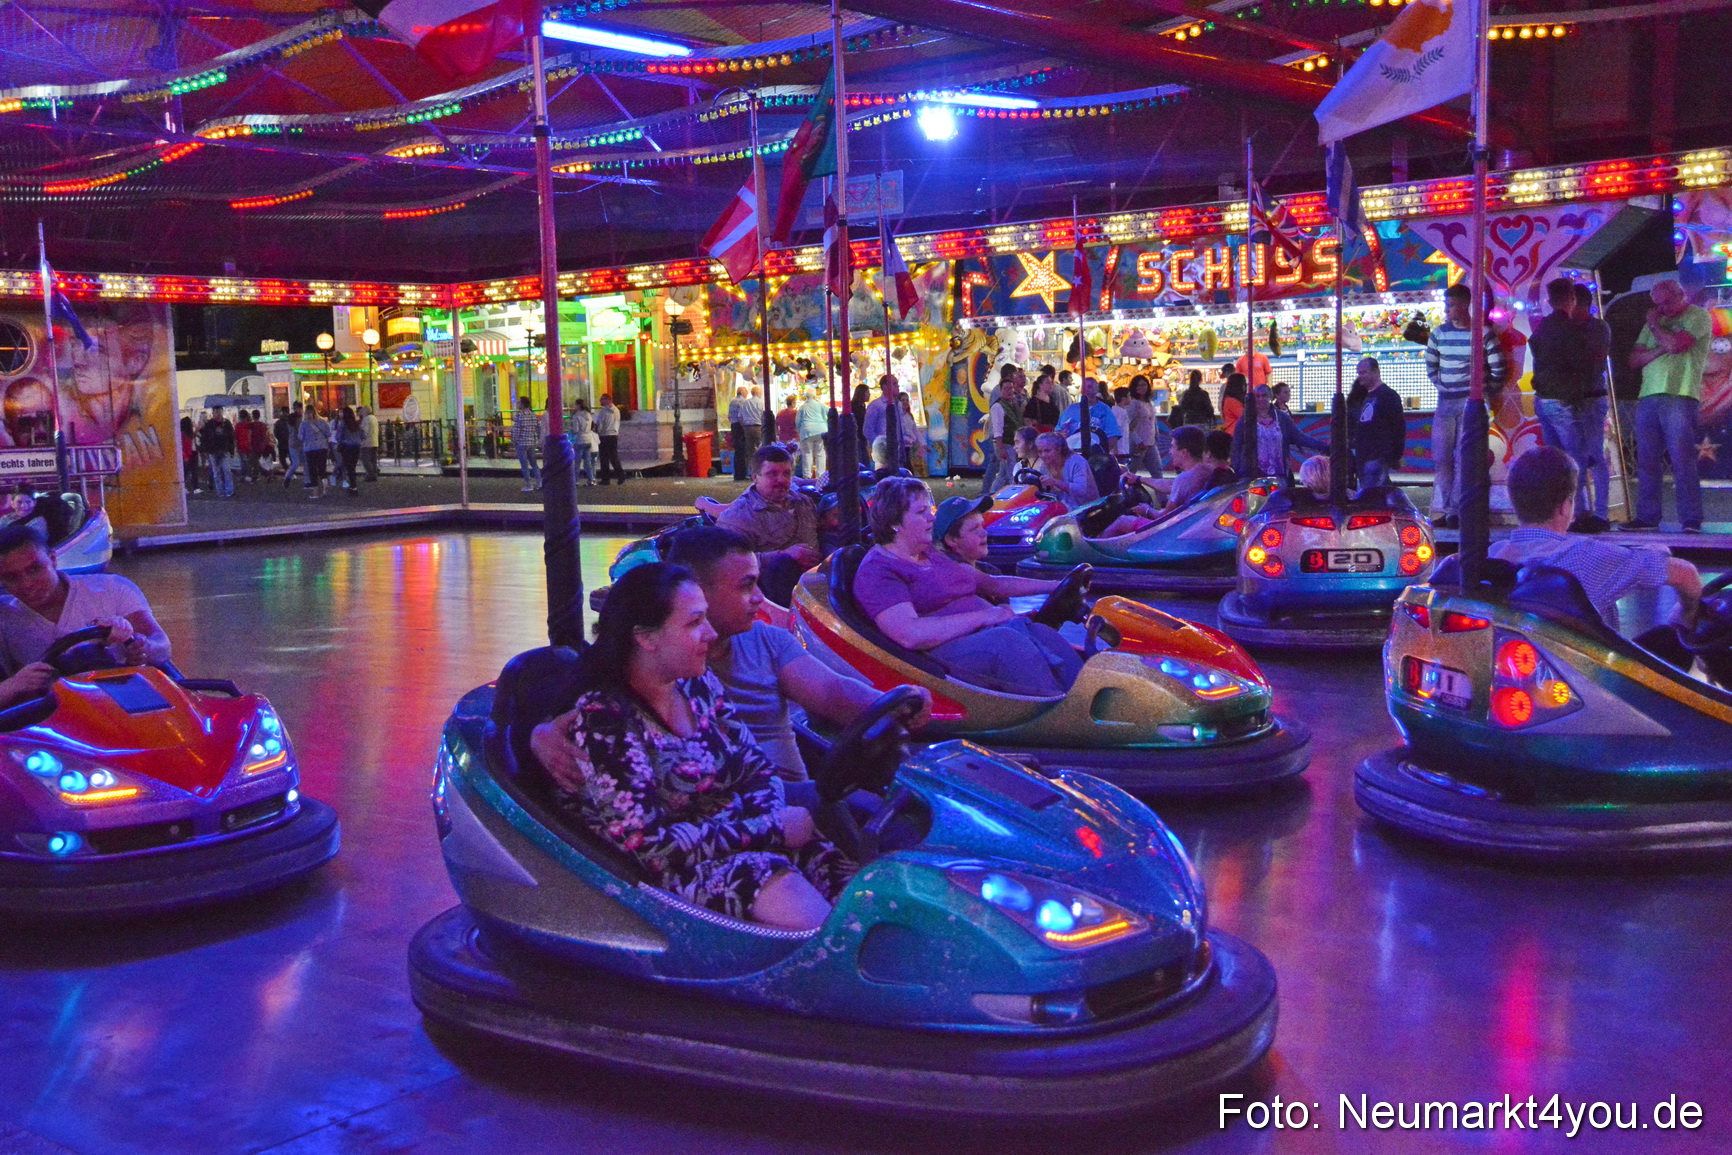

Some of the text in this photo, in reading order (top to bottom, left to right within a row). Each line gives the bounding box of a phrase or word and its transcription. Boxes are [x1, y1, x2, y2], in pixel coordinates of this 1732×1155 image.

[1136, 236, 1339, 294] SCHUSS
[0, 458, 55, 469] echts fahren
[1333, 553, 1372, 564] 20
